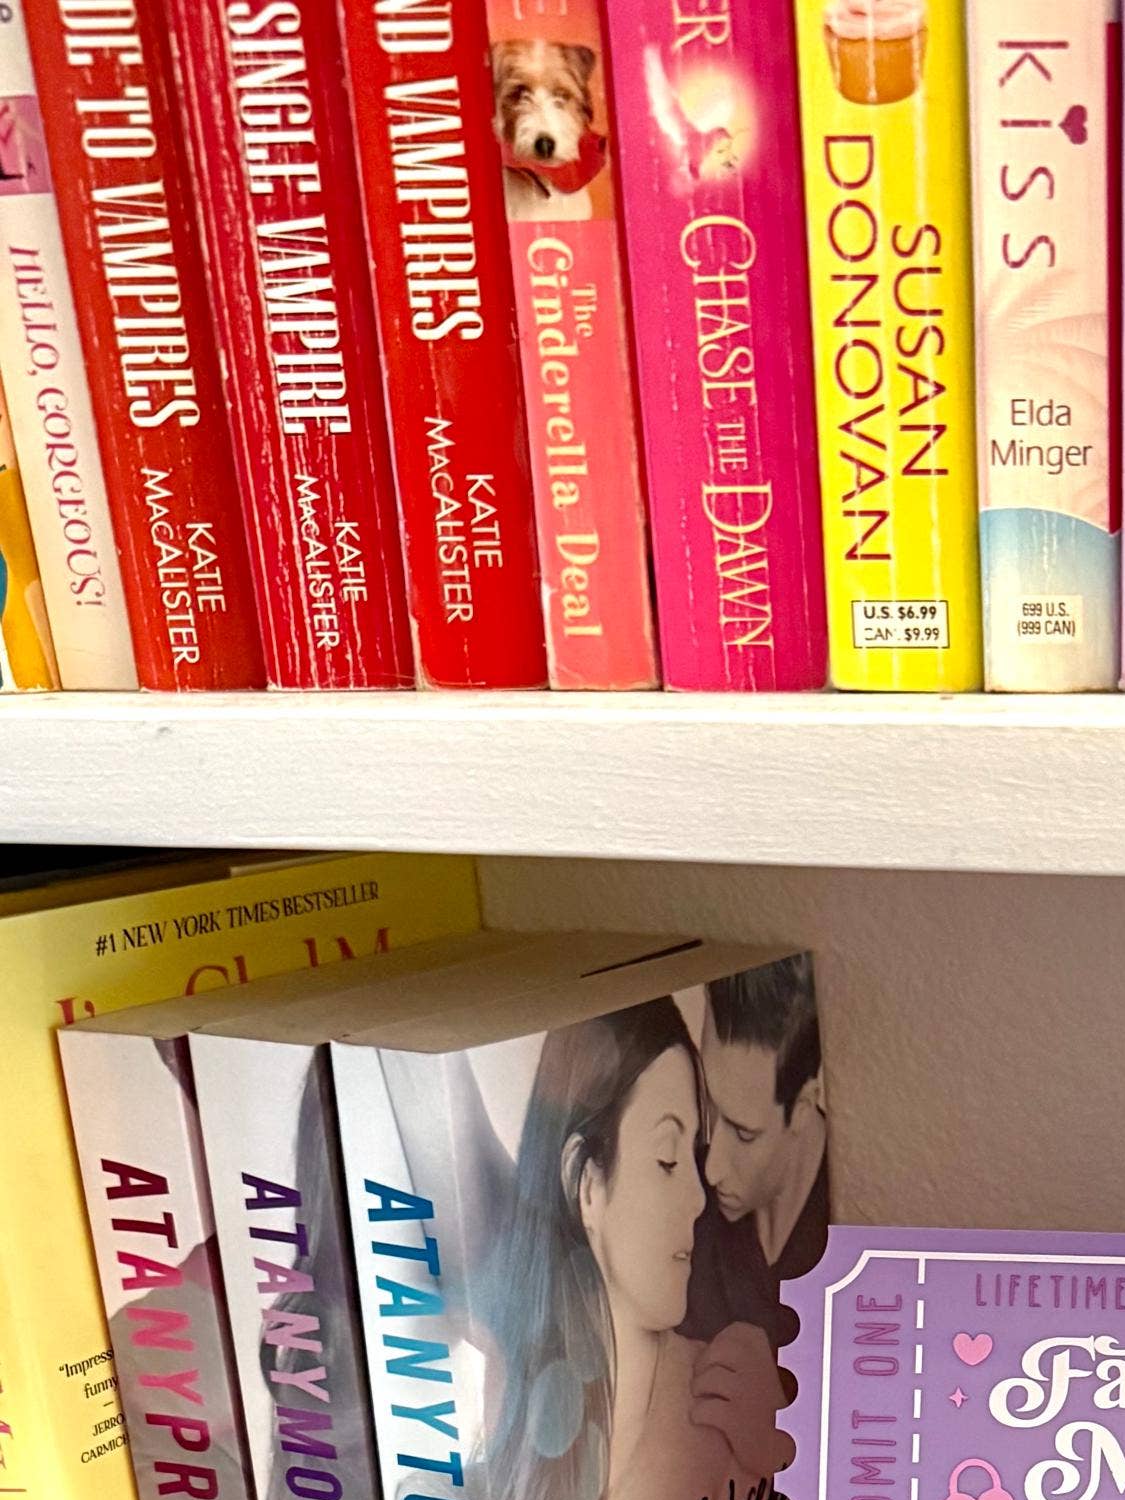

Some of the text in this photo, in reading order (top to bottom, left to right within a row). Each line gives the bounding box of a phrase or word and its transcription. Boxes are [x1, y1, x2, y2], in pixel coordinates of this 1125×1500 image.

[75, 87, 201, 428] TO VAMPIRES
[225, 0, 352, 436] SINGLE VAMPIRE
[571, 284, 594, 337] The
[823, 134, 892, 563] DONOVAN
[890, 224, 949, 476] SUSAN
[9, 246, 106, 608] HELLO, GORGEOUS!
[527, 236, 603, 638] Cinderella Deal
[680, 214, 774, 651] CHASE THE DAWN
[990, 440, 1092, 475] Minger
[1011, 399, 1072, 428] Elda
[141, 467, 201, 664] MACALISTER
[185, 522, 226, 612] KATIE
[897, 604, 938, 622] $6.99
[904, 626, 940, 643] $9.99
[1021, 602, 1070, 618] 699 U.S.
[1045, 618, 1076, 637] CAN)
[95, 880, 381, 957] #1 NEW YORK TIMES BESTSELLER
[854, 1292, 904, 1379] ONE
